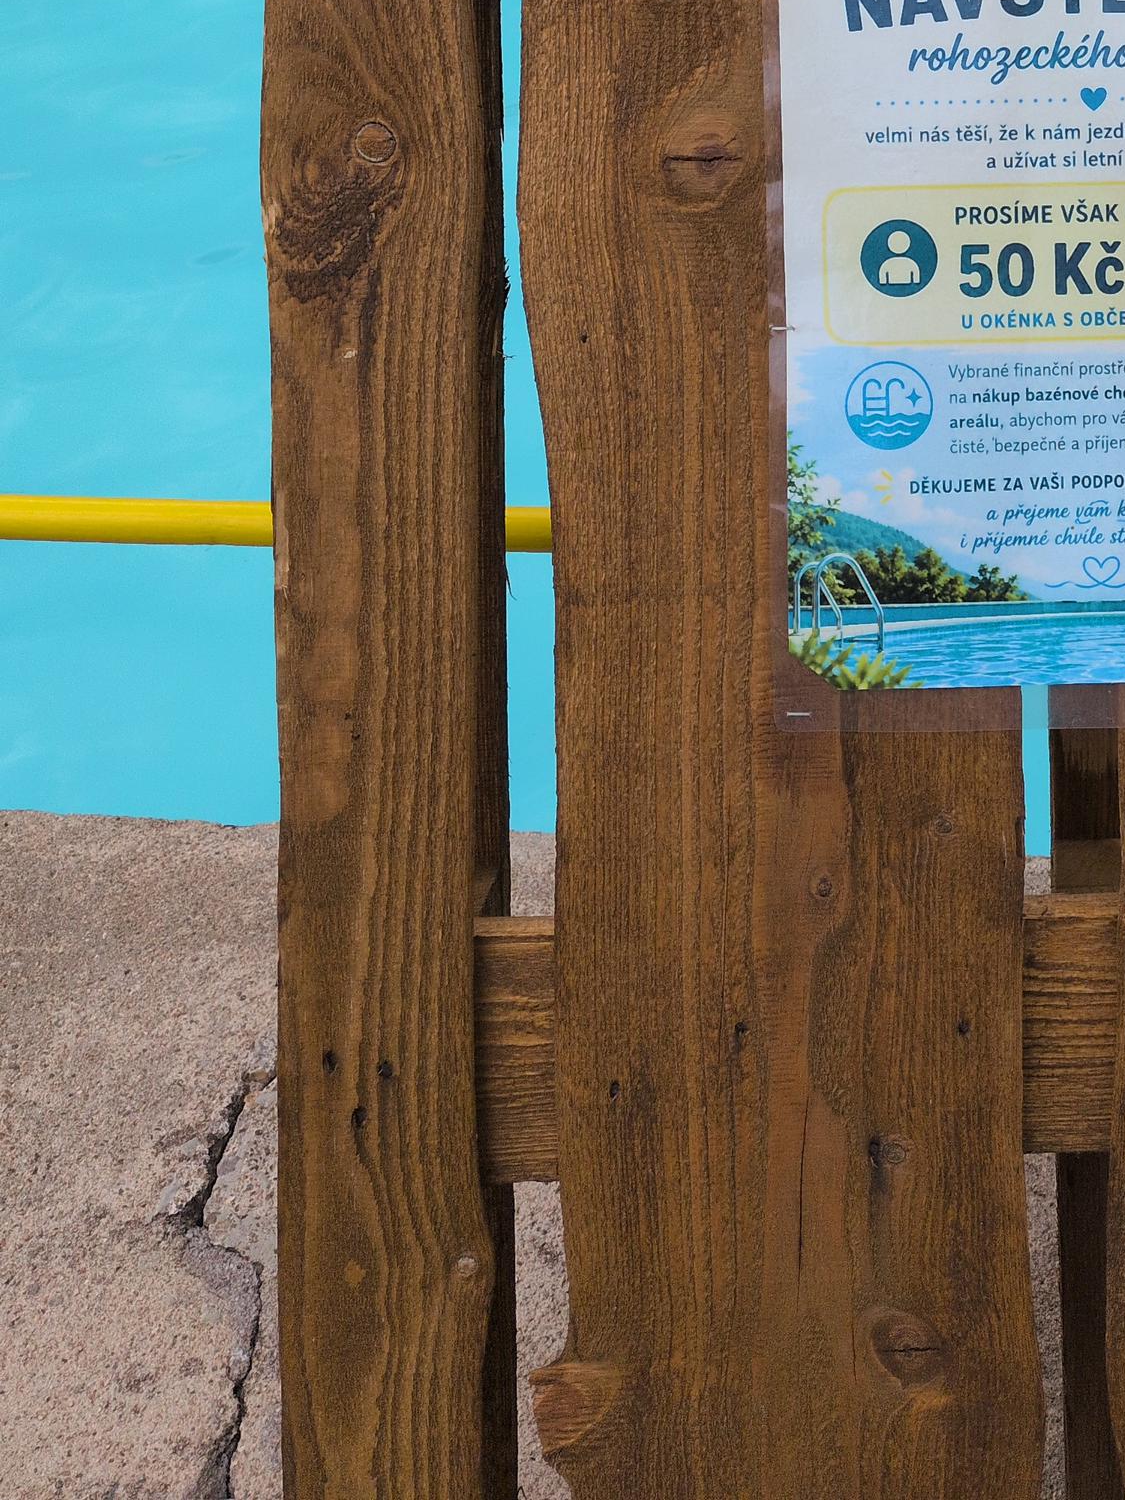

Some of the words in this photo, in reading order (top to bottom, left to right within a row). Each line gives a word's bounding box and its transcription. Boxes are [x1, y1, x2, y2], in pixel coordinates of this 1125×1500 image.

[865, 126, 913, 144] velmi
[919, 125, 950, 143] nás
[955, 124, 993, 144] těší,
[998, 124, 1019, 141] že
[1025, 123, 1036, 141] k
[1042, 123, 1081, 140] nám
[986, 156, 997, 169] a
[1003, 151, 1057, 169] užívat
[1062, 150, 1076, 168] si
[1083, 149, 1124, 167] letní
[955, 200, 1053, 226] PROSÍME
[1060, 198, 1120, 224] VŠAK
[959, 242, 1035, 299] 50
[1054, 240, 1125, 296] Kč
[961, 313, 973, 330] U
[980, 308, 1056, 329] OKÉNKA
[1063, 311, 1074, 327] S
[947, 363, 1009, 383] Vybrané
[1013, 361, 1074, 378] finanční
[949, 393, 967, 405] na
[972, 387, 1021, 407] nákup
[1025, 385, 1099, 402] bazénové
[949, 412, 1004, 430] areálu,
[1009, 411, 1077, 431] abychom
[1082, 414, 1107, 429] pro
[949, 438, 990, 455] čisté,
[991, 435, 1066, 456] bezpečné
[1071, 439, 1080, 451] a
[909, 475, 997, 495] DĚKUJEME
[1003, 477, 1024, 492] ZA
[1029, 471, 1065, 491] VAŠI
[986, 509, 1000, 521] a
[1002, 503, 1071, 527] přejeme
[1074, 499, 1113, 525] vám
[960, 533, 969, 549] i
[971, 529, 1050, 555] příjemné
[1054, 525, 1106, 546] chvíle
